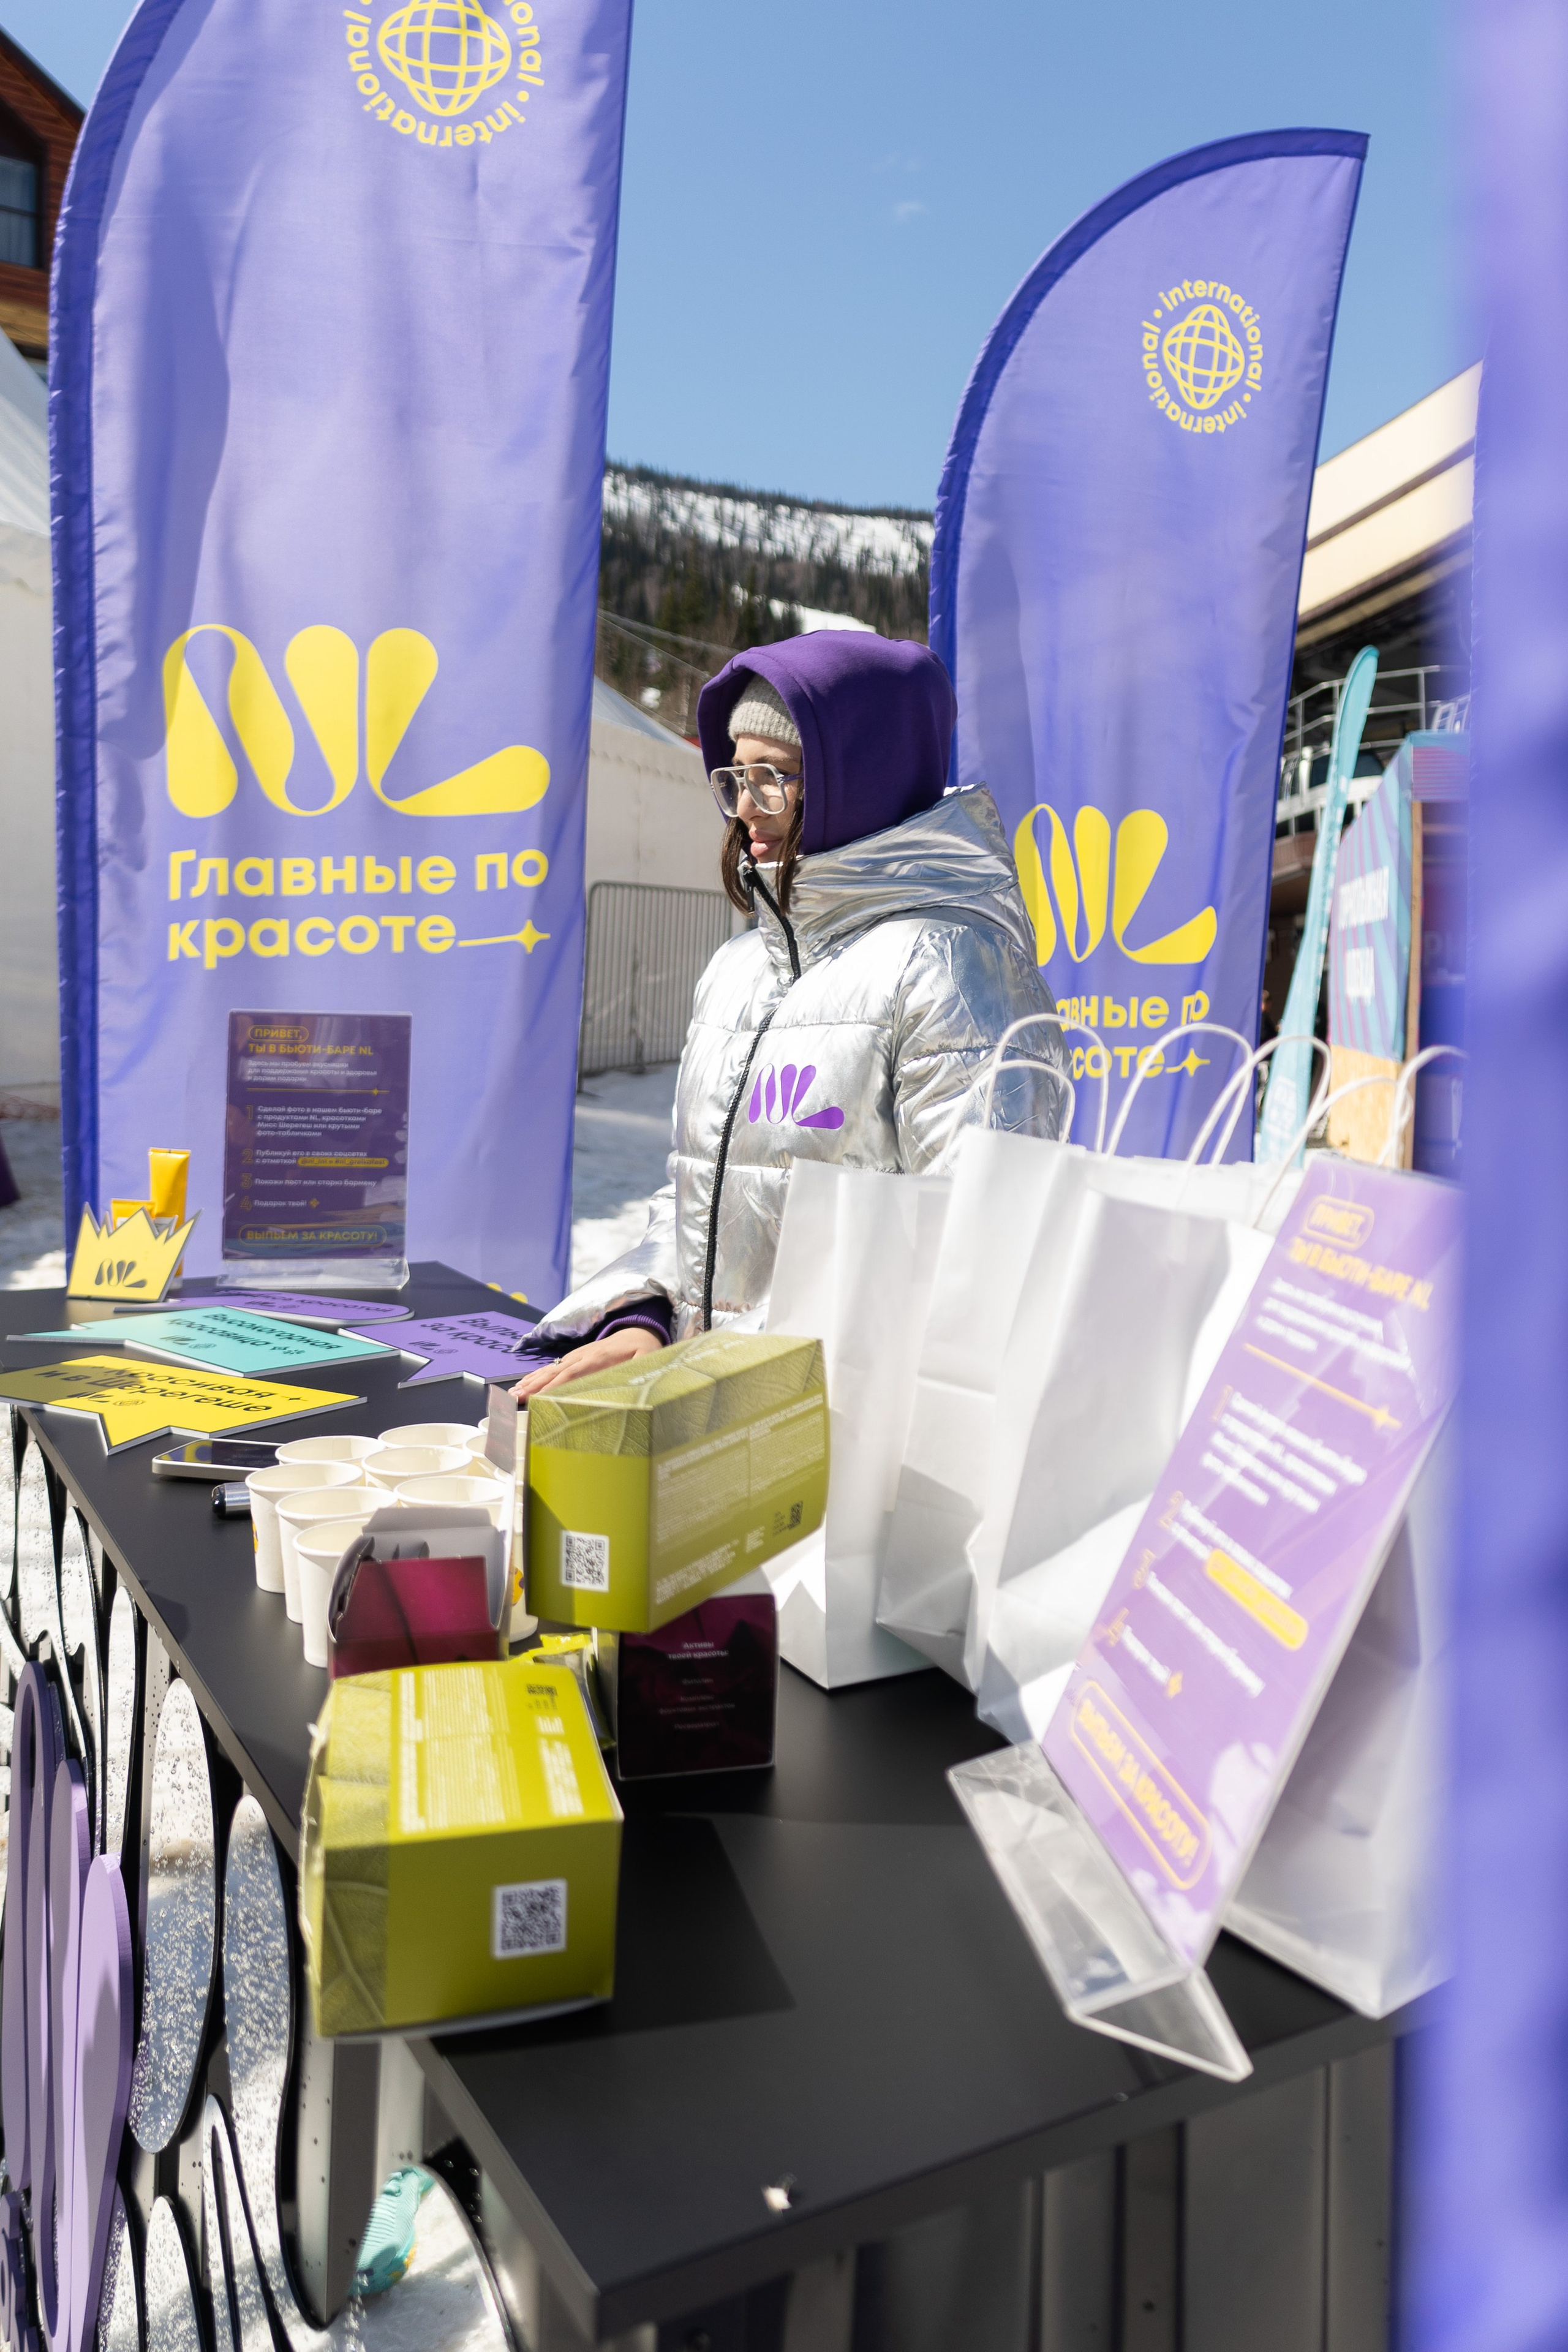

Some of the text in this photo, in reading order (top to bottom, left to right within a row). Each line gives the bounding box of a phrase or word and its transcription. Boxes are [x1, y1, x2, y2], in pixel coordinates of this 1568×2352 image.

[342, 9, 526, 147] international
[1158, 279, 1263, 391] international
[1141, 320, 1246, 433] international
[168, 849, 549, 901] Главные по
[168, 914, 456, 970] красоте
[1055, 995, 1169, 1033] авные
[249, 1043, 374, 1055] ТЫ В БЬЮТИ-БАРЕ NL
[254, 1028, 303, 1039] ПРИВЕТ,
[1069, 1045, 1165, 1080] соте
[246, 1230, 377, 1241] ВЫПЬЕМ ЗА КРАСОТУ!
[165, 1318, 273, 1347] красавица
[202, 1313, 344, 1351] Высокогорная
[458, 1317, 524, 1340] Выпь
[86, 1376, 273, 1412] Шерегеше
[103, 1366, 277, 1399] Красивая
[682, 1641, 715, 1650] Активы
